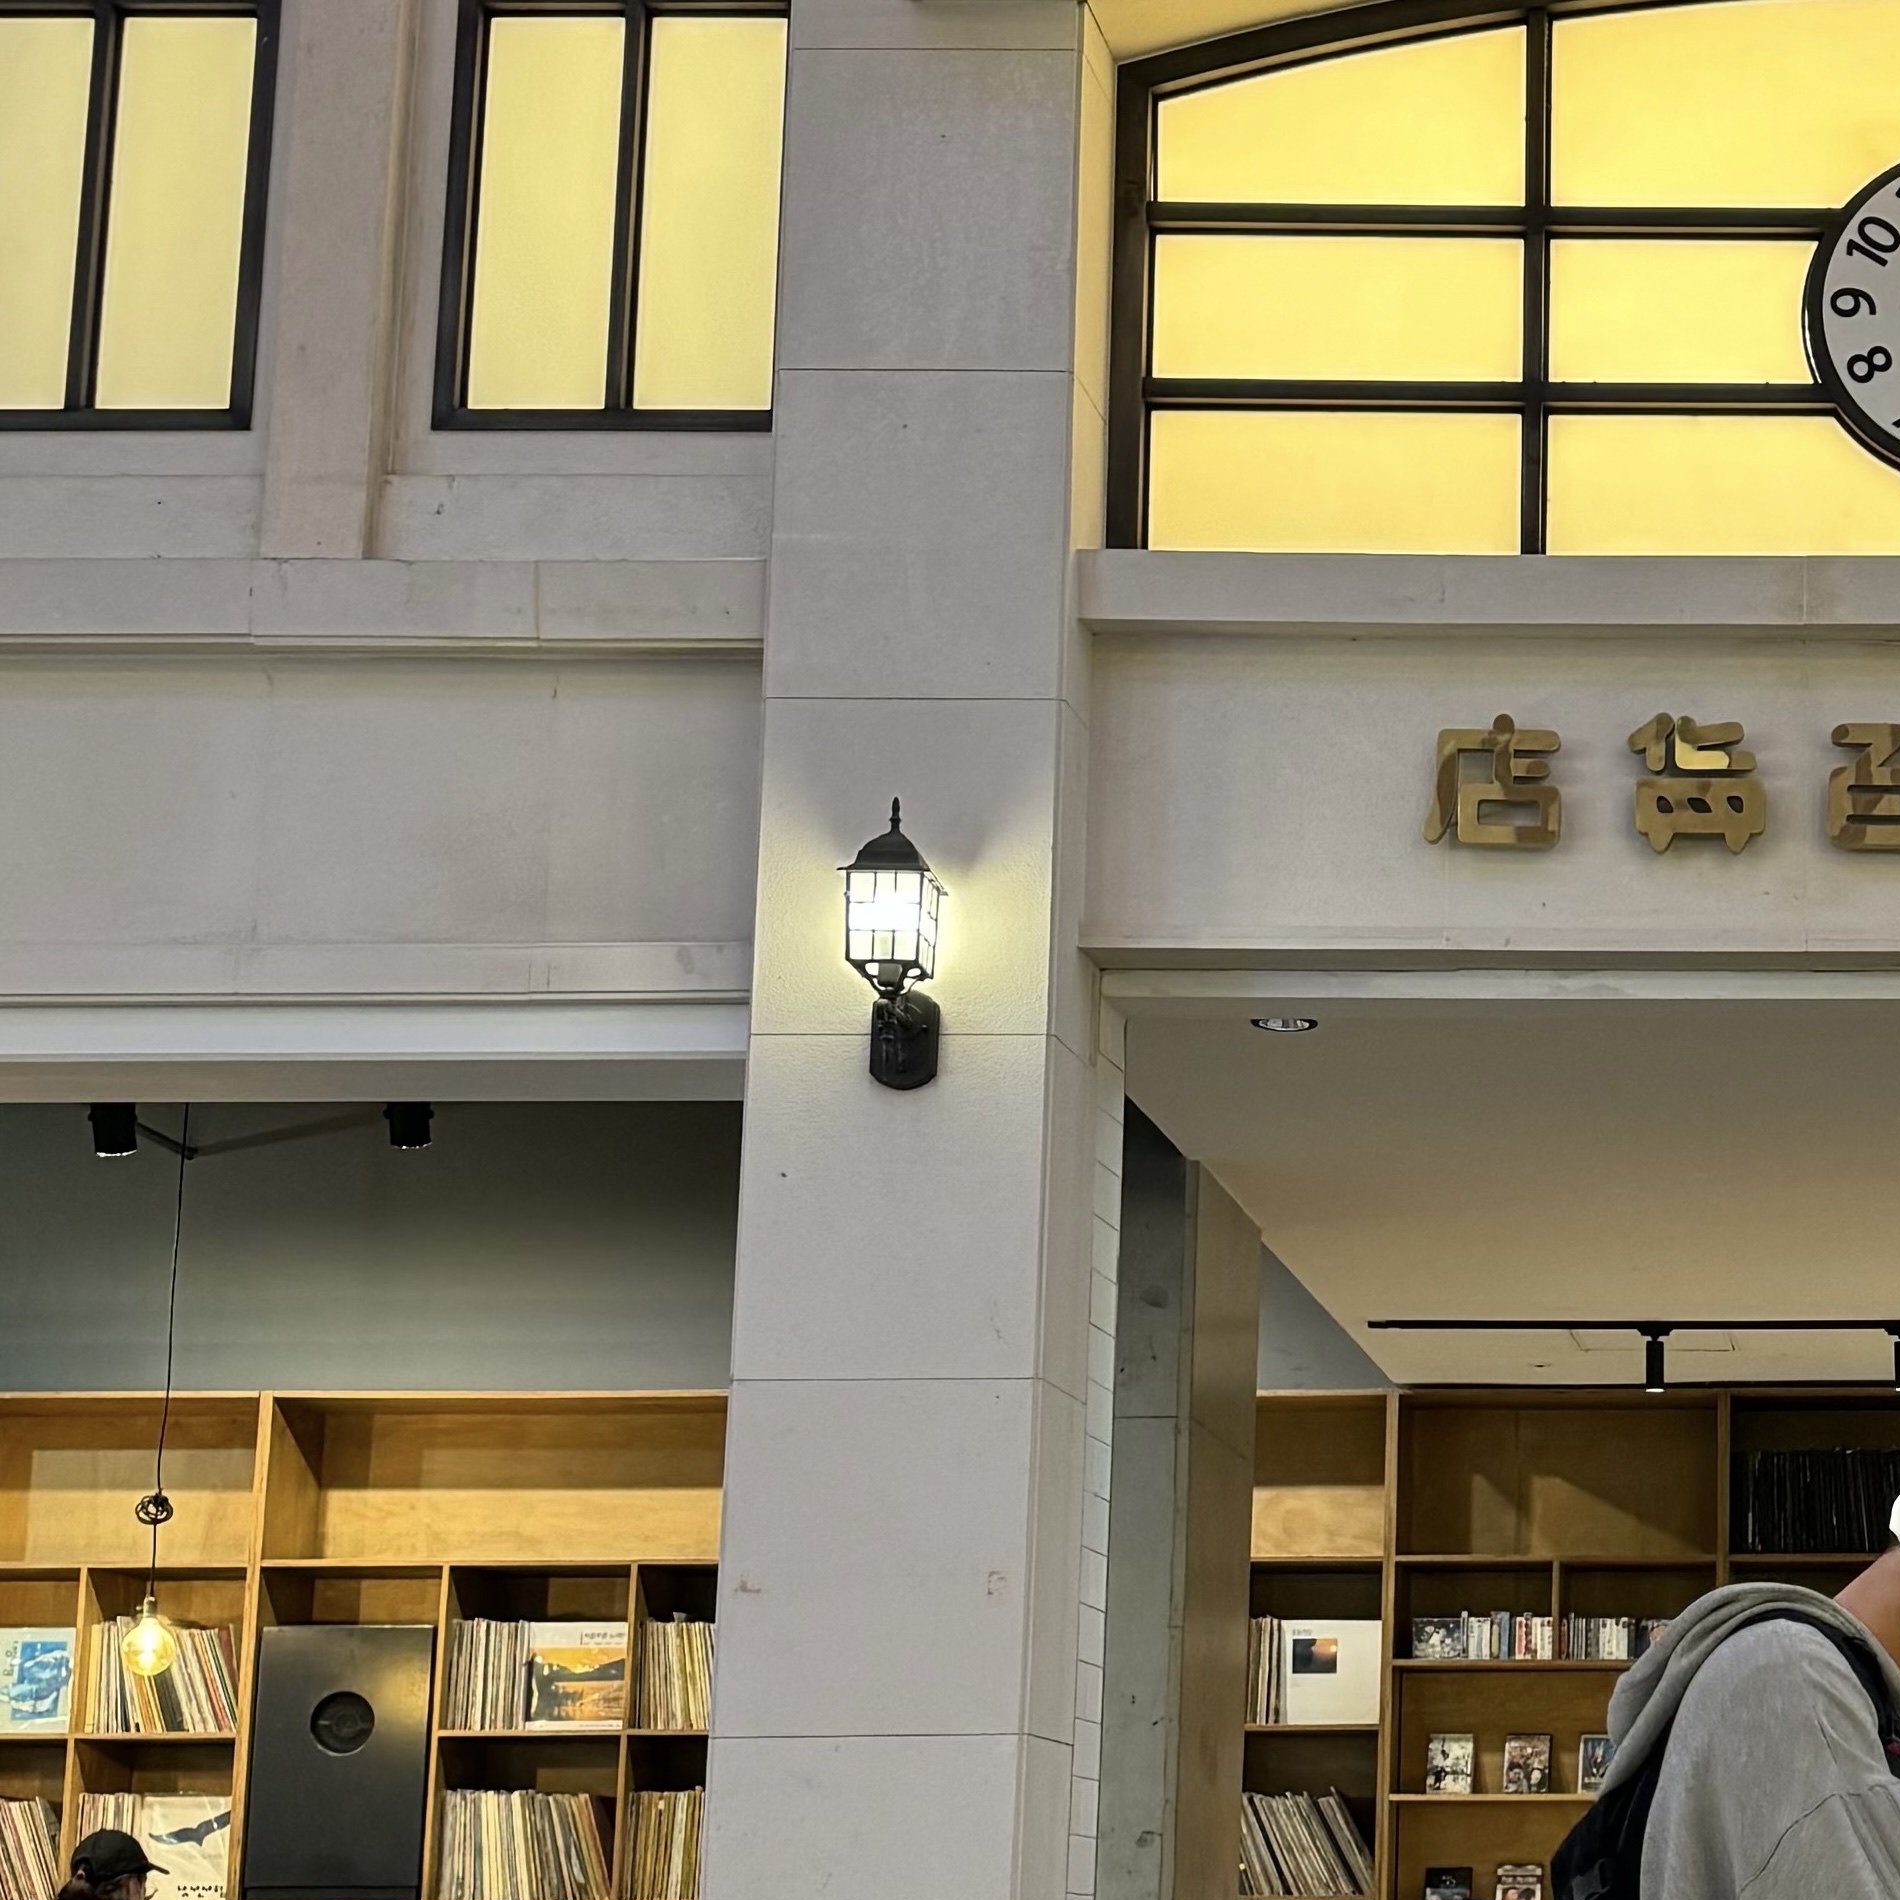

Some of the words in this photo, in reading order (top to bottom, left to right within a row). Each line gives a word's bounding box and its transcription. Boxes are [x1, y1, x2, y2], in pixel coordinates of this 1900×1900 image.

[1846, 216, 1900, 267] 10
[1830, 287, 1876, 318] 9
[1846, 345, 1893, 383] 8
